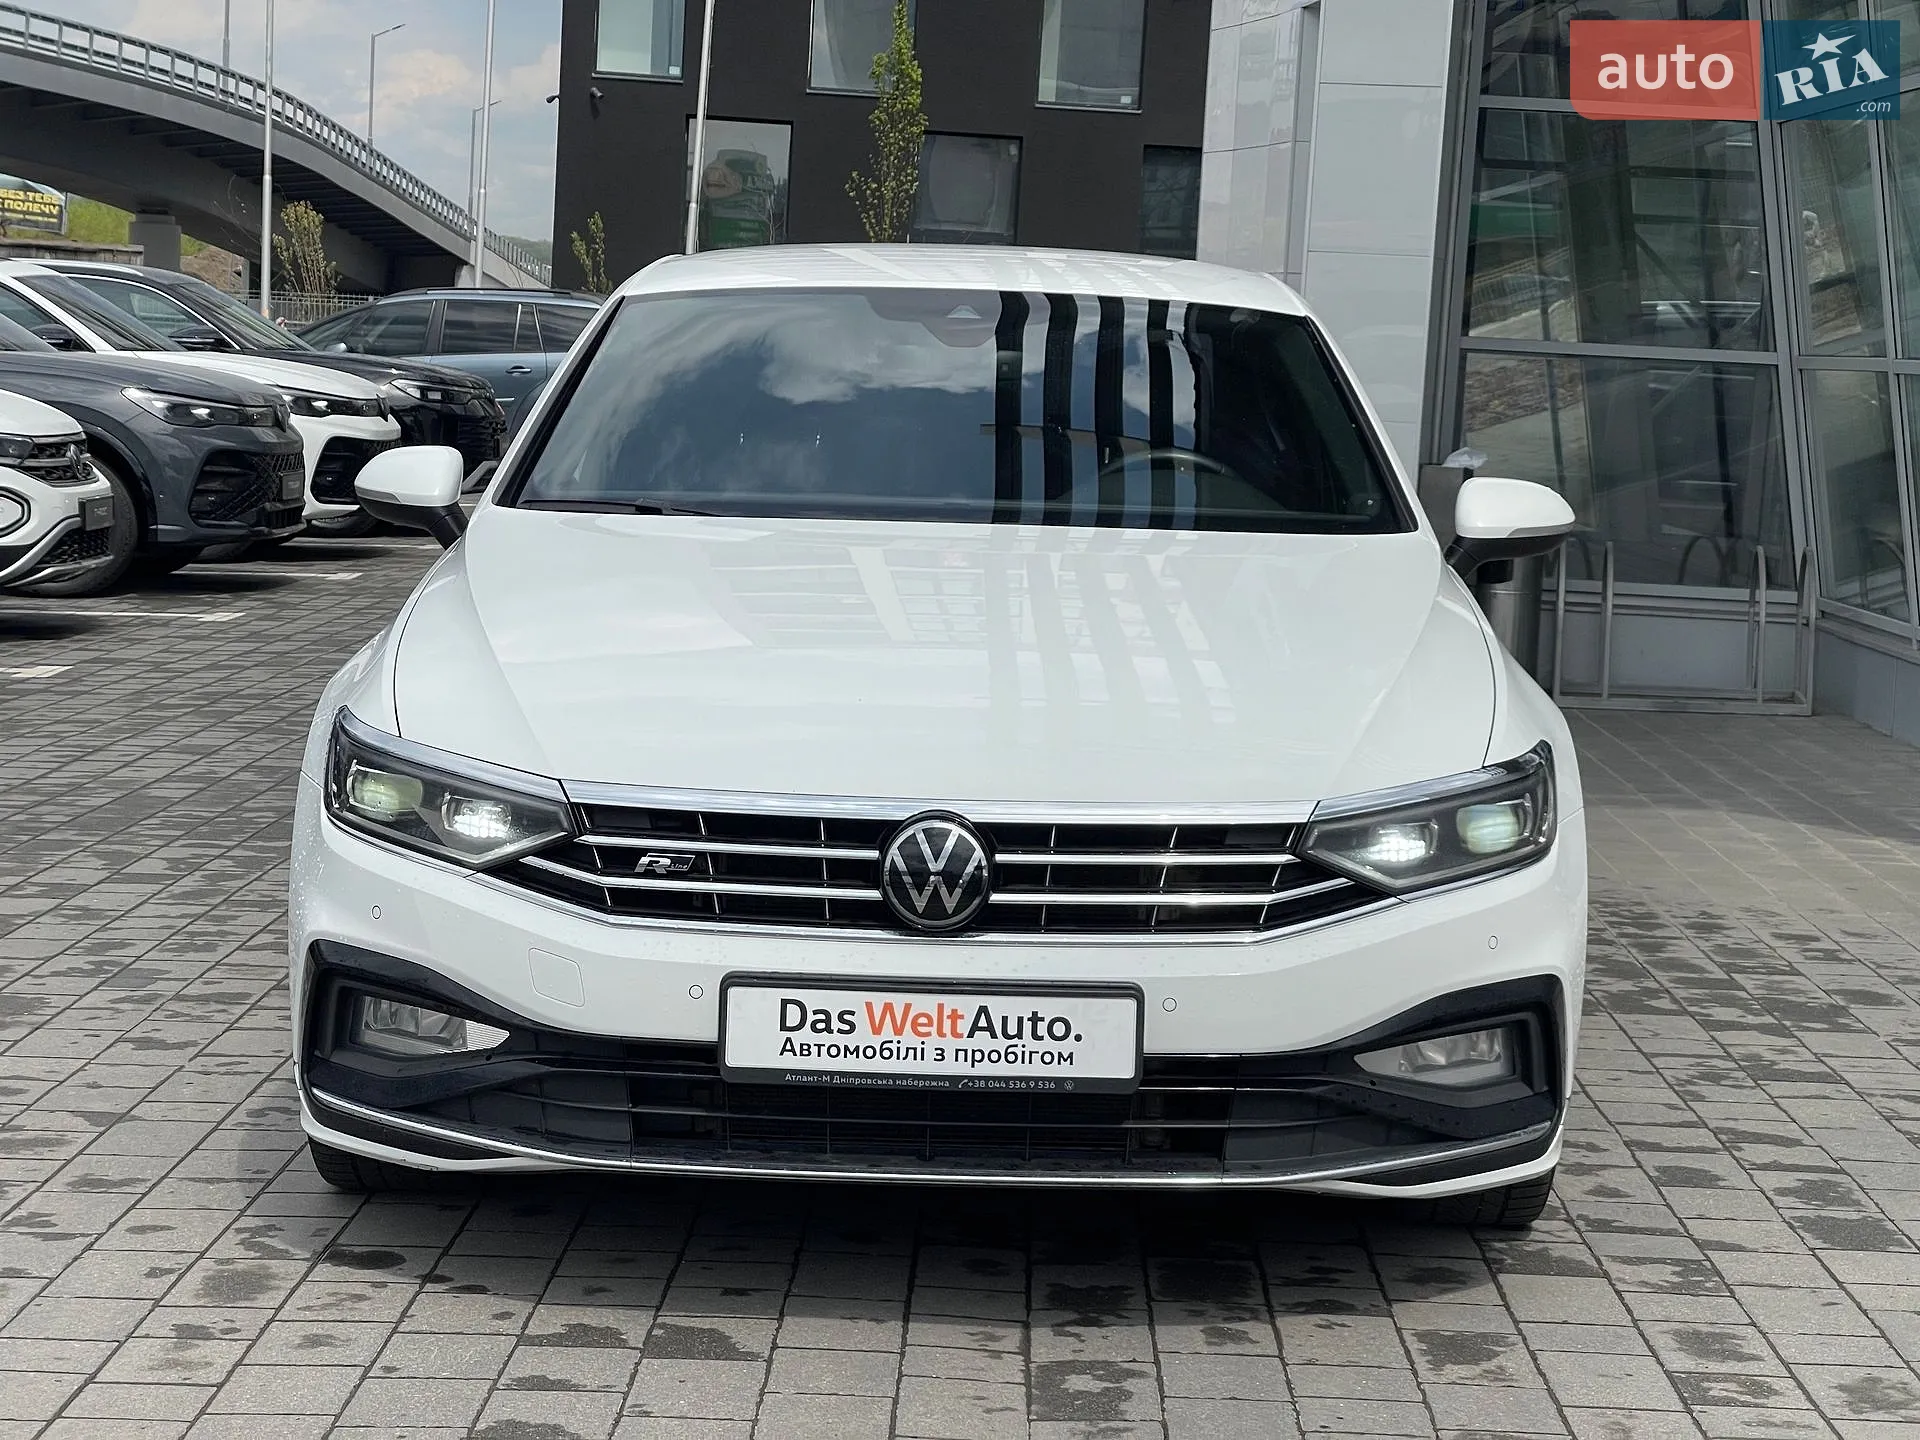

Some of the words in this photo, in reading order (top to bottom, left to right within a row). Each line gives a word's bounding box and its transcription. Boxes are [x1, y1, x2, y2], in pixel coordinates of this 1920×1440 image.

[4, 199, 59, 215] ПОЛЕЧУ
[779, 998, 857, 1035] Das
[779, 1036, 926, 1062] Автомобілі
[933, 1047, 946, 1062] з
[954, 1044, 1074, 1069] пробігом
[832, 1075, 893, 1086] Дніпровська
[896, 1078, 950, 1088] набережна
[967, 1079, 986, 1088] +38
[988, 1080, 1006, 1088] 044
[1009, 1080, 1027, 1089] 536
[1029, 1080, 1035, 1089] 9
[1037, 1081, 1056, 1089] 536
